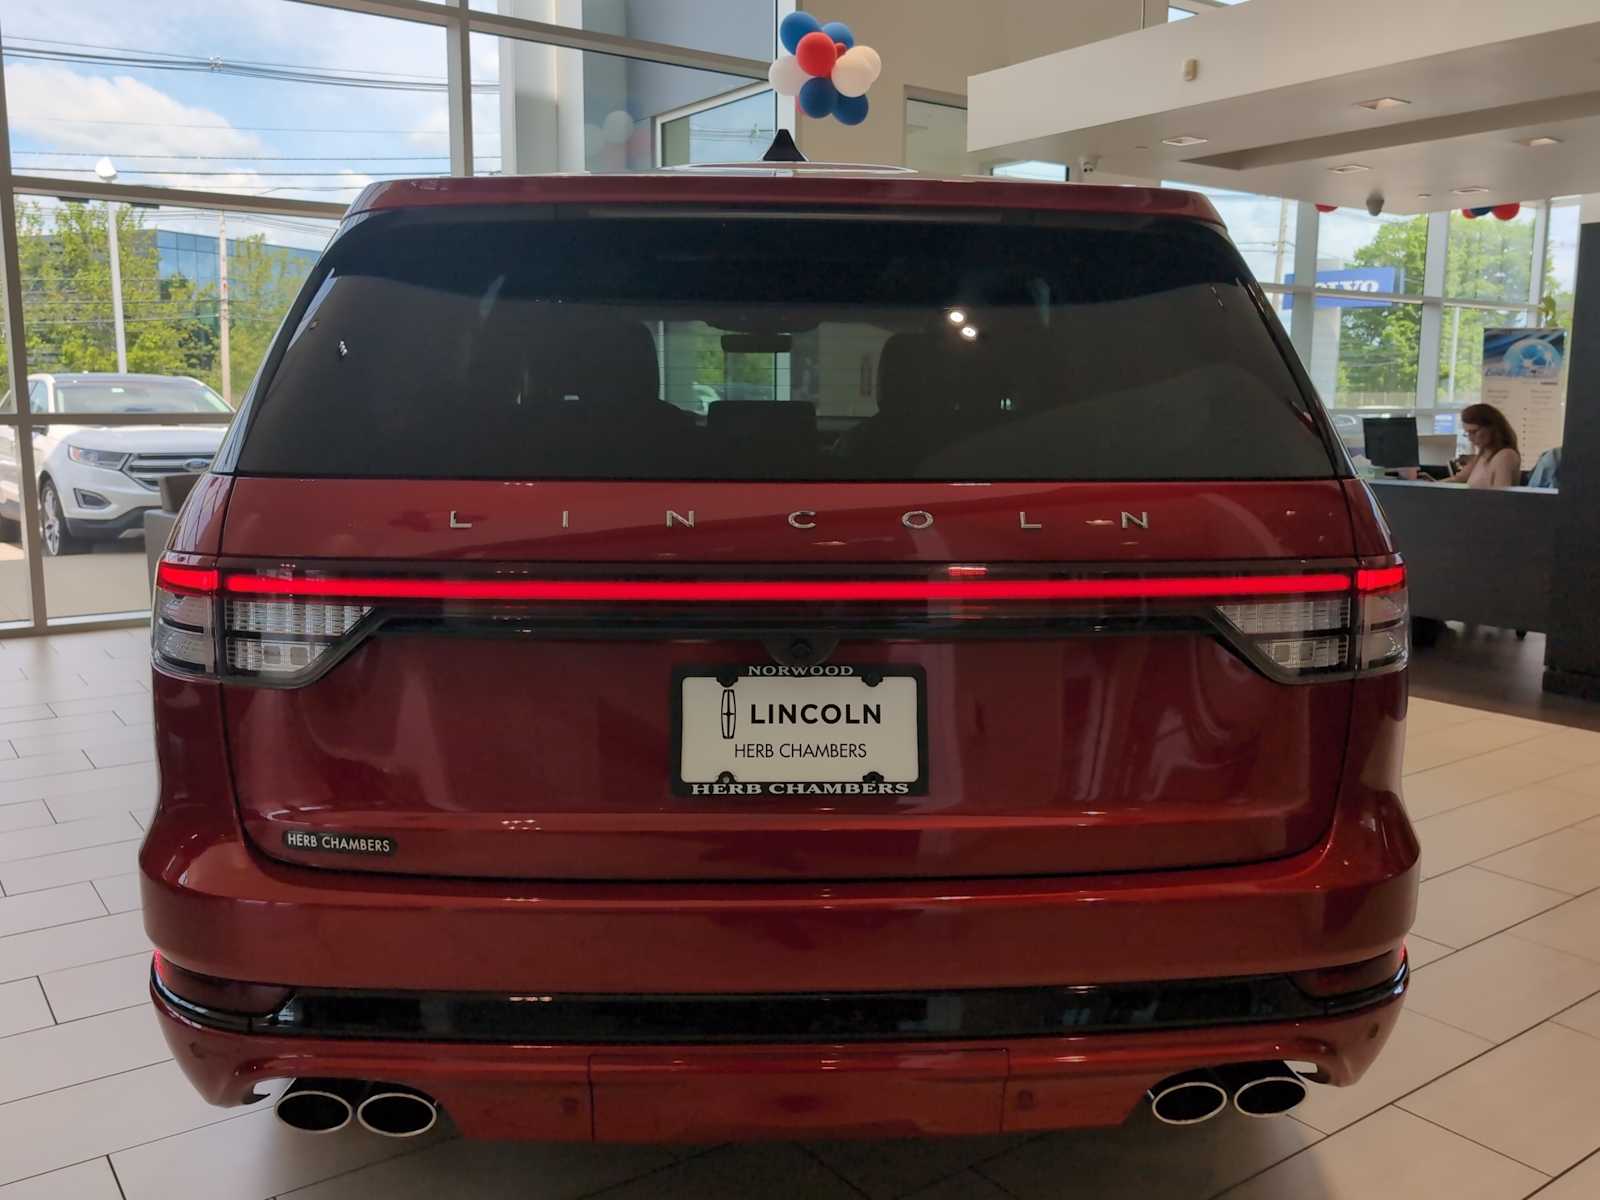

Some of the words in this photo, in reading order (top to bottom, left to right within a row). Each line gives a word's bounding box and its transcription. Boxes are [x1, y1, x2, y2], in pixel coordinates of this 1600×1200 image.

[449, 509, 1149, 530] LINCOLN
[747, 665, 854, 676] NORWOOD
[750, 703, 882, 724] LINCOLN
[734, 743, 774, 758] HERB
[779, 743, 867, 758] CHAMBERS
[691, 783, 762, 795] HERB
[768, 783, 910, 795] CHAMBERS
[287, 832, 318, 847] HERB
[321, 836, 390, 852] CHAMBERS
